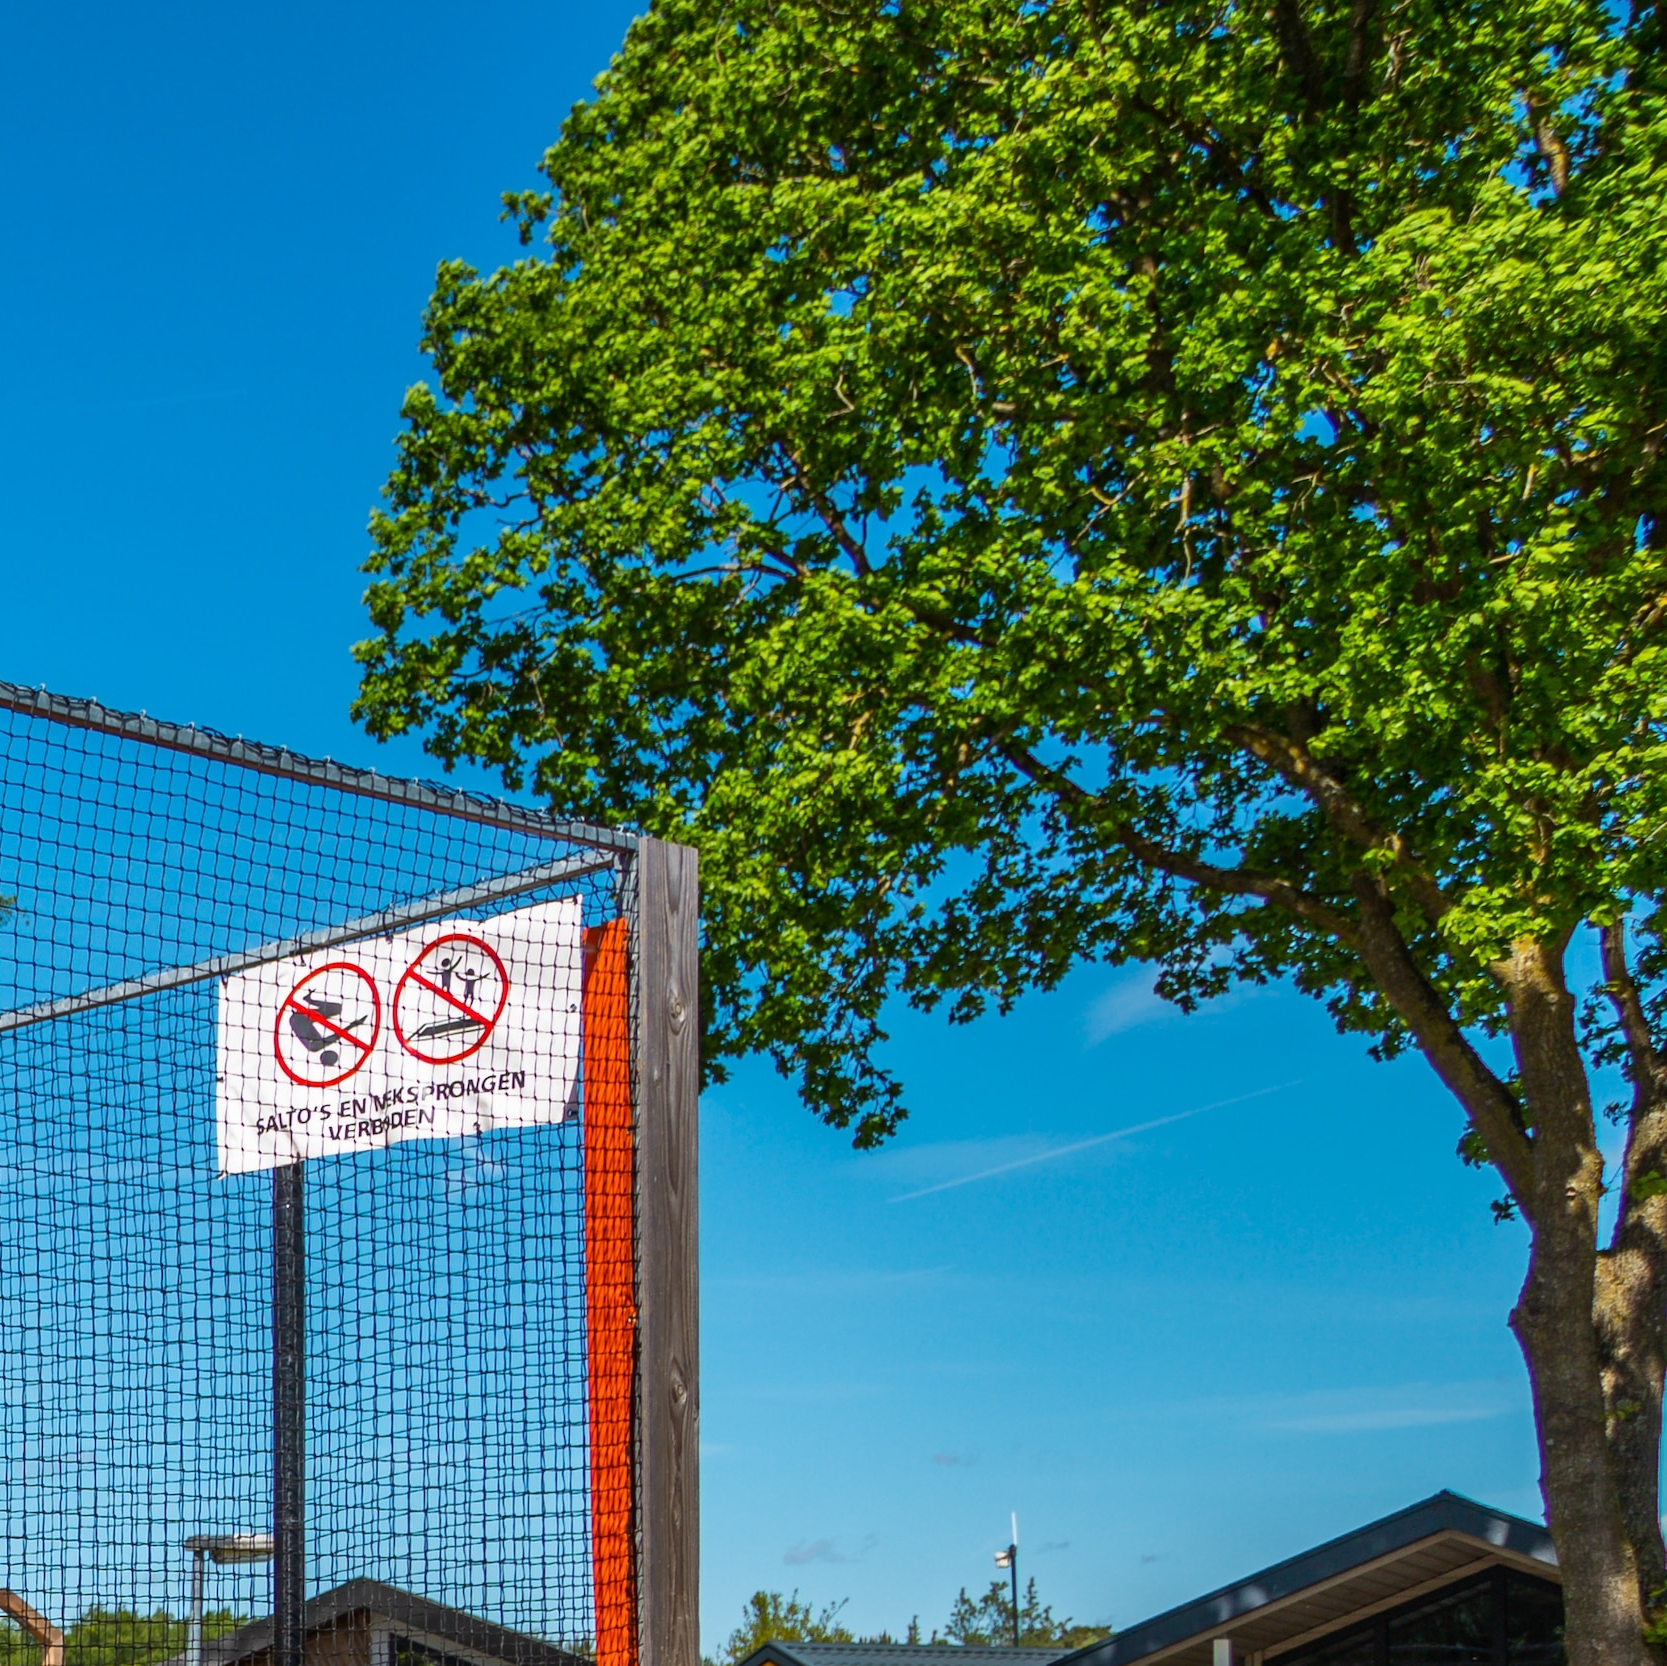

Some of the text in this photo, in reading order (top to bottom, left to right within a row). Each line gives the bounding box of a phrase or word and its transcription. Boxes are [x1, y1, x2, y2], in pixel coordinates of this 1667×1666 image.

[256, 1070, 526, 1136] SALTO'S EN NEKSPRONGEN
[328, 1108, 435, 1142] VERBODEN
